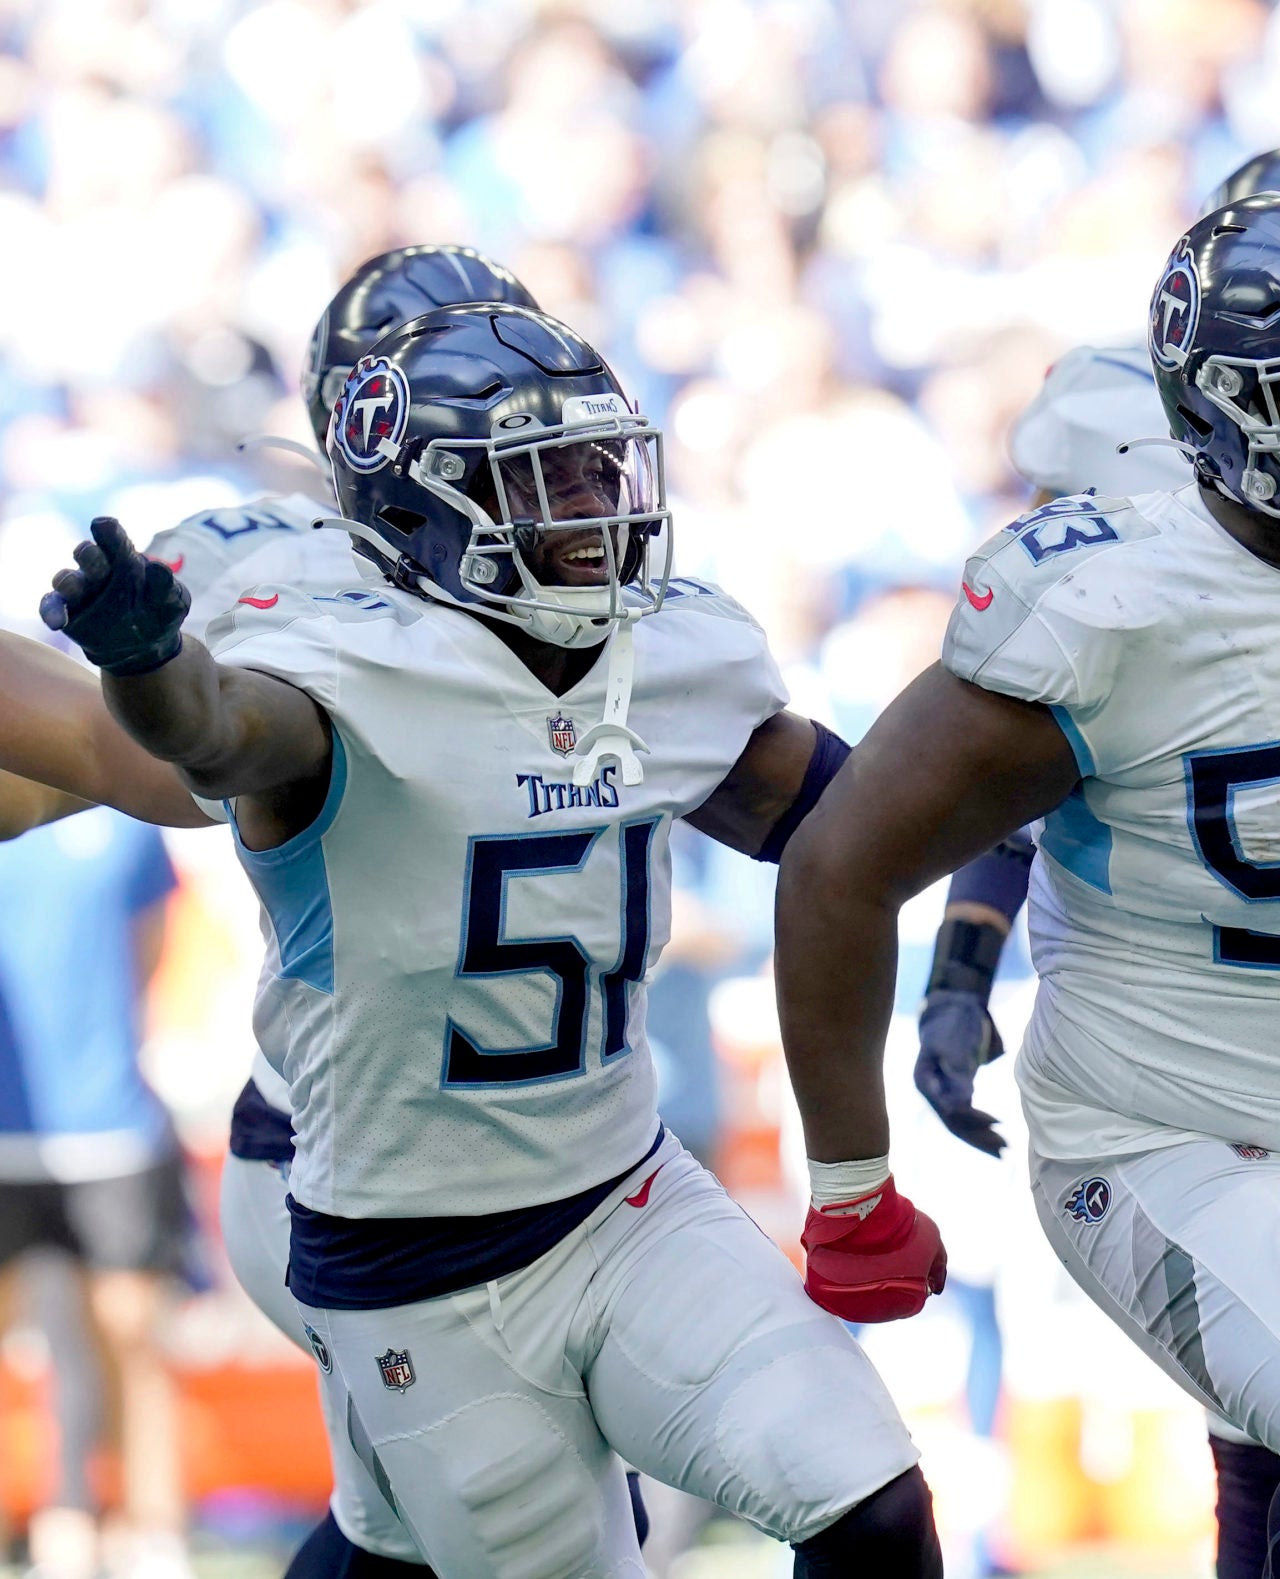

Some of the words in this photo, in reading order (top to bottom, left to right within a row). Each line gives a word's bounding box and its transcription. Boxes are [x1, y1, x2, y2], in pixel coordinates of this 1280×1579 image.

[353, 396, 394, 452] T
[581, 398, 618, 415] TITANS
[553, 732, 575, 749] NFL
[516, 766, 619, 818] TITANS
[439, 813, 664, 1090] 51
[385, 1365, 411, 1384] NFL
